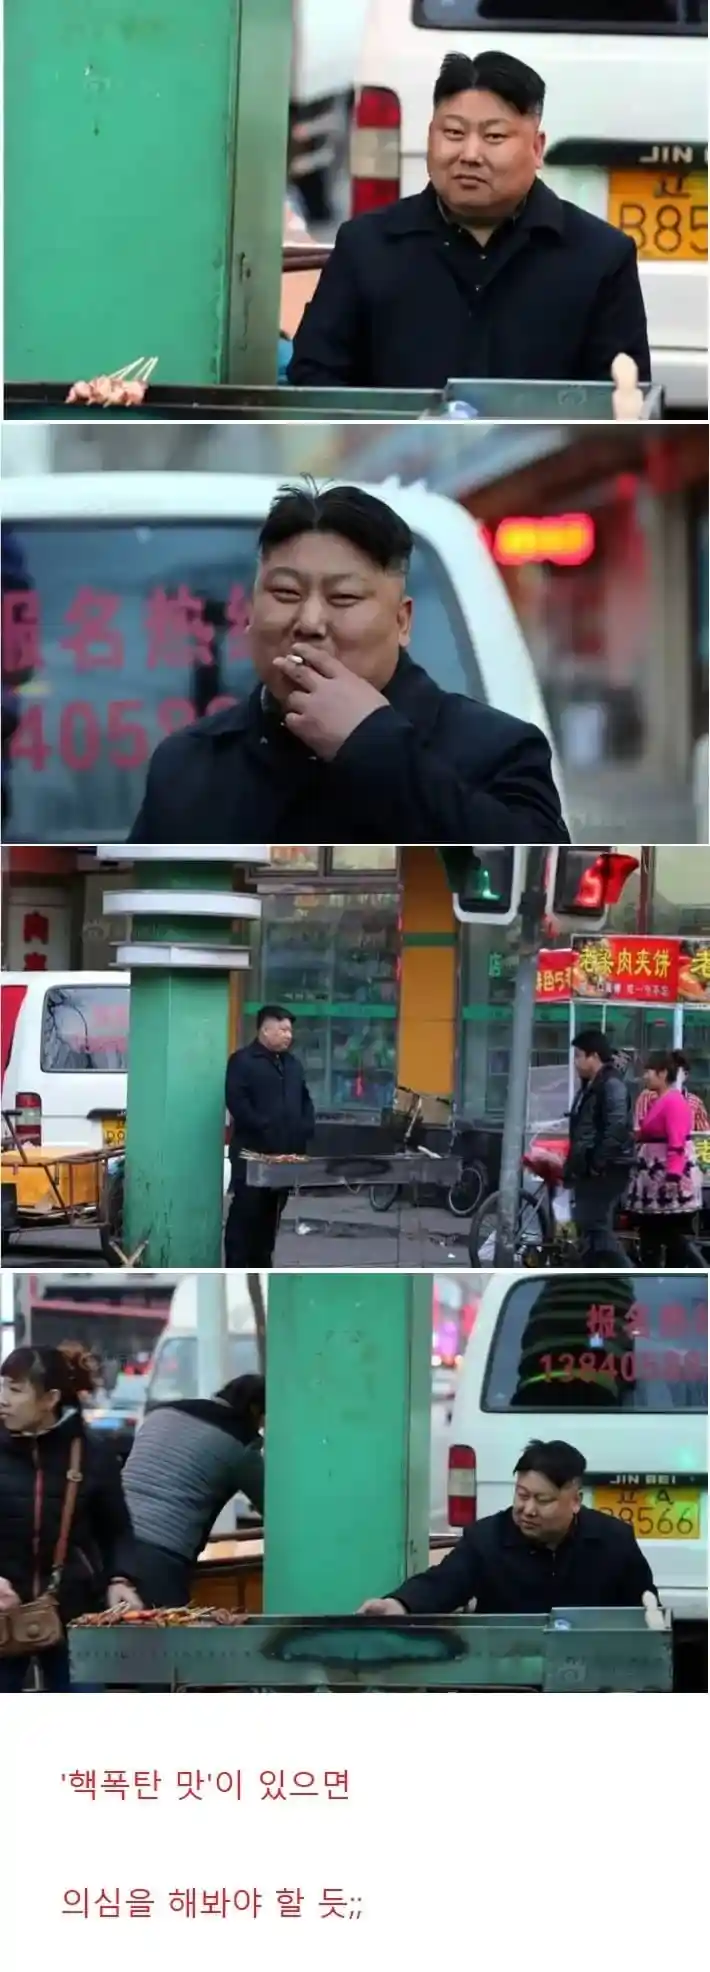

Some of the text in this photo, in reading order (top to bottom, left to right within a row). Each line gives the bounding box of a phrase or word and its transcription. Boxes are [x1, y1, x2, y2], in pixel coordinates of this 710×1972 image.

[640, 146, 693, 163] JIN
[610, 1475, 676, 1484] JIN BEI
